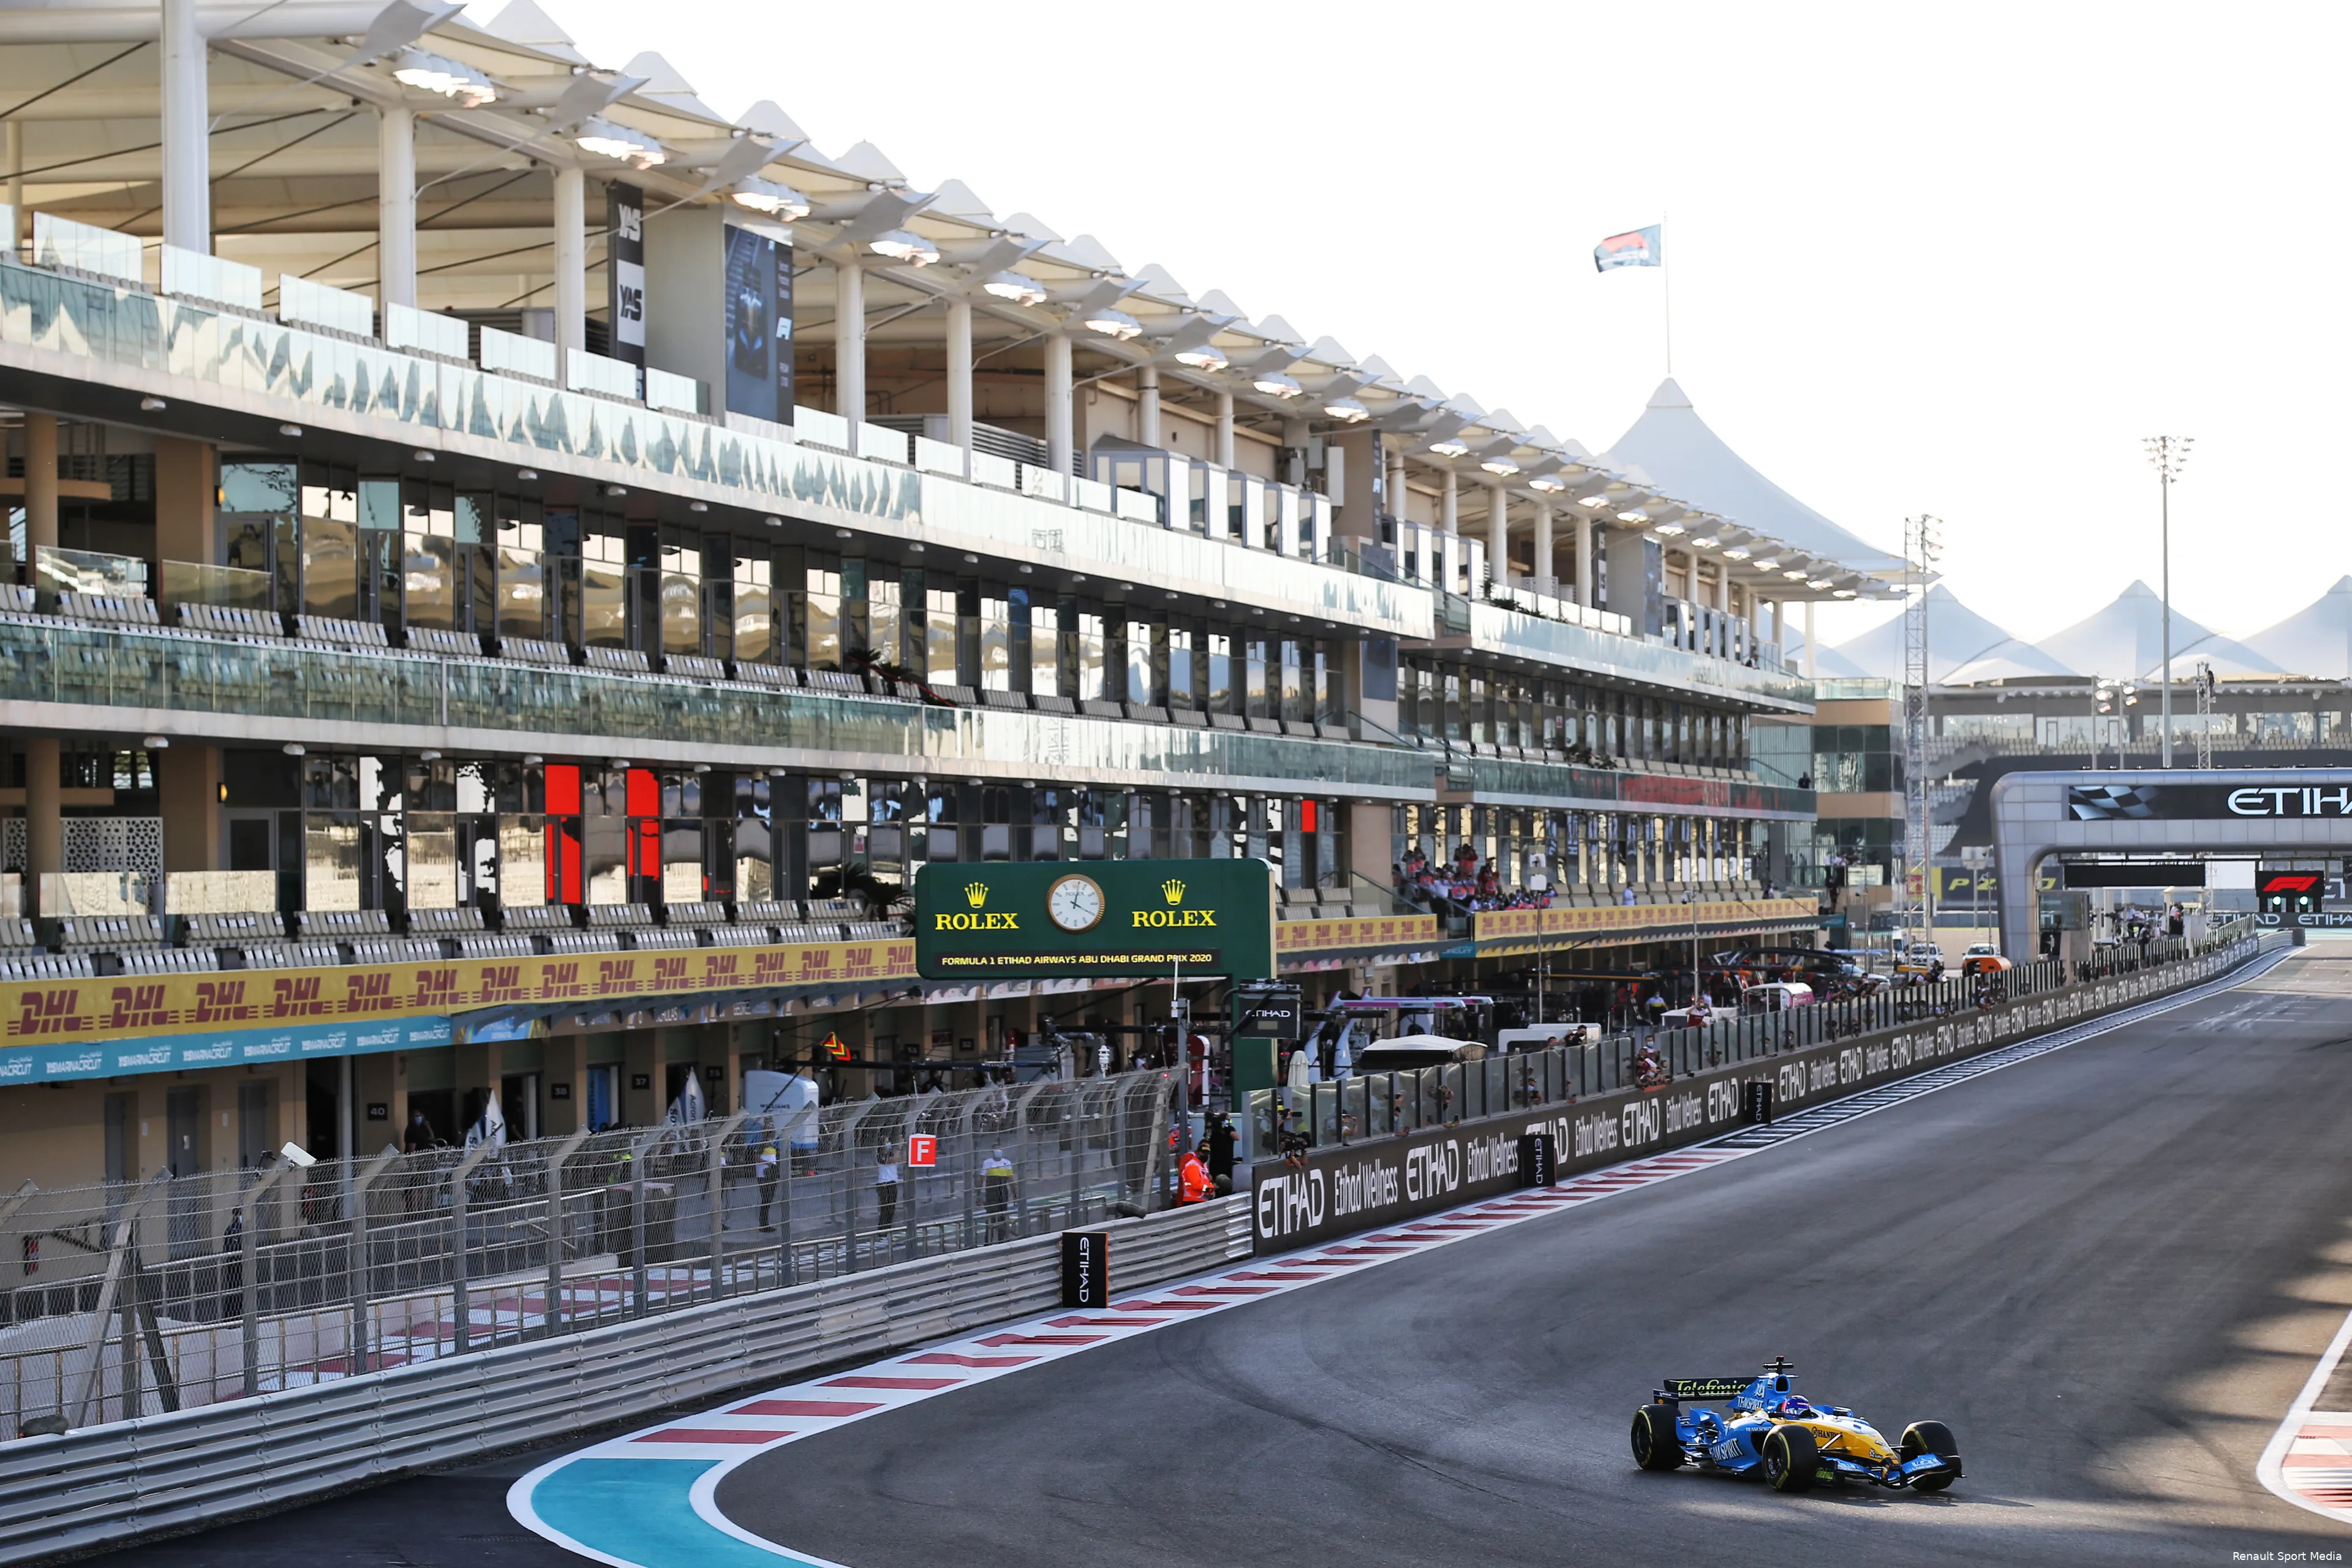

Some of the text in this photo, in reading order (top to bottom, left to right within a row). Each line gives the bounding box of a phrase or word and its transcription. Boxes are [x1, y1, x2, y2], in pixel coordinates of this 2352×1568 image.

[618, 203, 641, 242] YAS
[619, 285, 642, 322] YAS
[935, 910, 1217, 930] ROLEX ROLEX
[990, 957, 995, 965] 1
[997, 956, 1031, 965] ETIHAD
[1033, 956, 1077, 964] AIRWAYS
[1079, 955, 1098, 963] ABU
[1100, 954, 1129, 963] DHABI
[1189, 954, 1212, 962] 2020
[20, 946, 914, 1035] DHL DHL DHL DHL DHL DHL DHL DHL DHL DHL DHL DHL DHL DHL DHL
[1779, 1061, 1806, 1102] ETIHAD
[1840, 1046, 1863, 1084] ETIHAD
[1708, 1077, 1738, 1123] ETIHAD
[1575, 1114, 1593, 1157] Etihad
[1594, 1111, 1618, 1152] Wellness
[1623, 1098, 1660, 1147] ETIHAD
[917, 1140, 930, 1161] F
[1406, 1139, 1459, 1201] ETIHAD
[1468, 1136, 1489, 1183] Etihad
[1490, 1133, 1518, 1177] Wellness
[1258, 1169, 1324, 1238] ETIHAD
[1335, 1162, 1361, 1216] Etihad
[1363, 1158, 1398, 1210] Wellness
[1080, 1237, 1089, 1302] ETIHAD
[1721, 1438, 1743, 1460] SPIRIT
